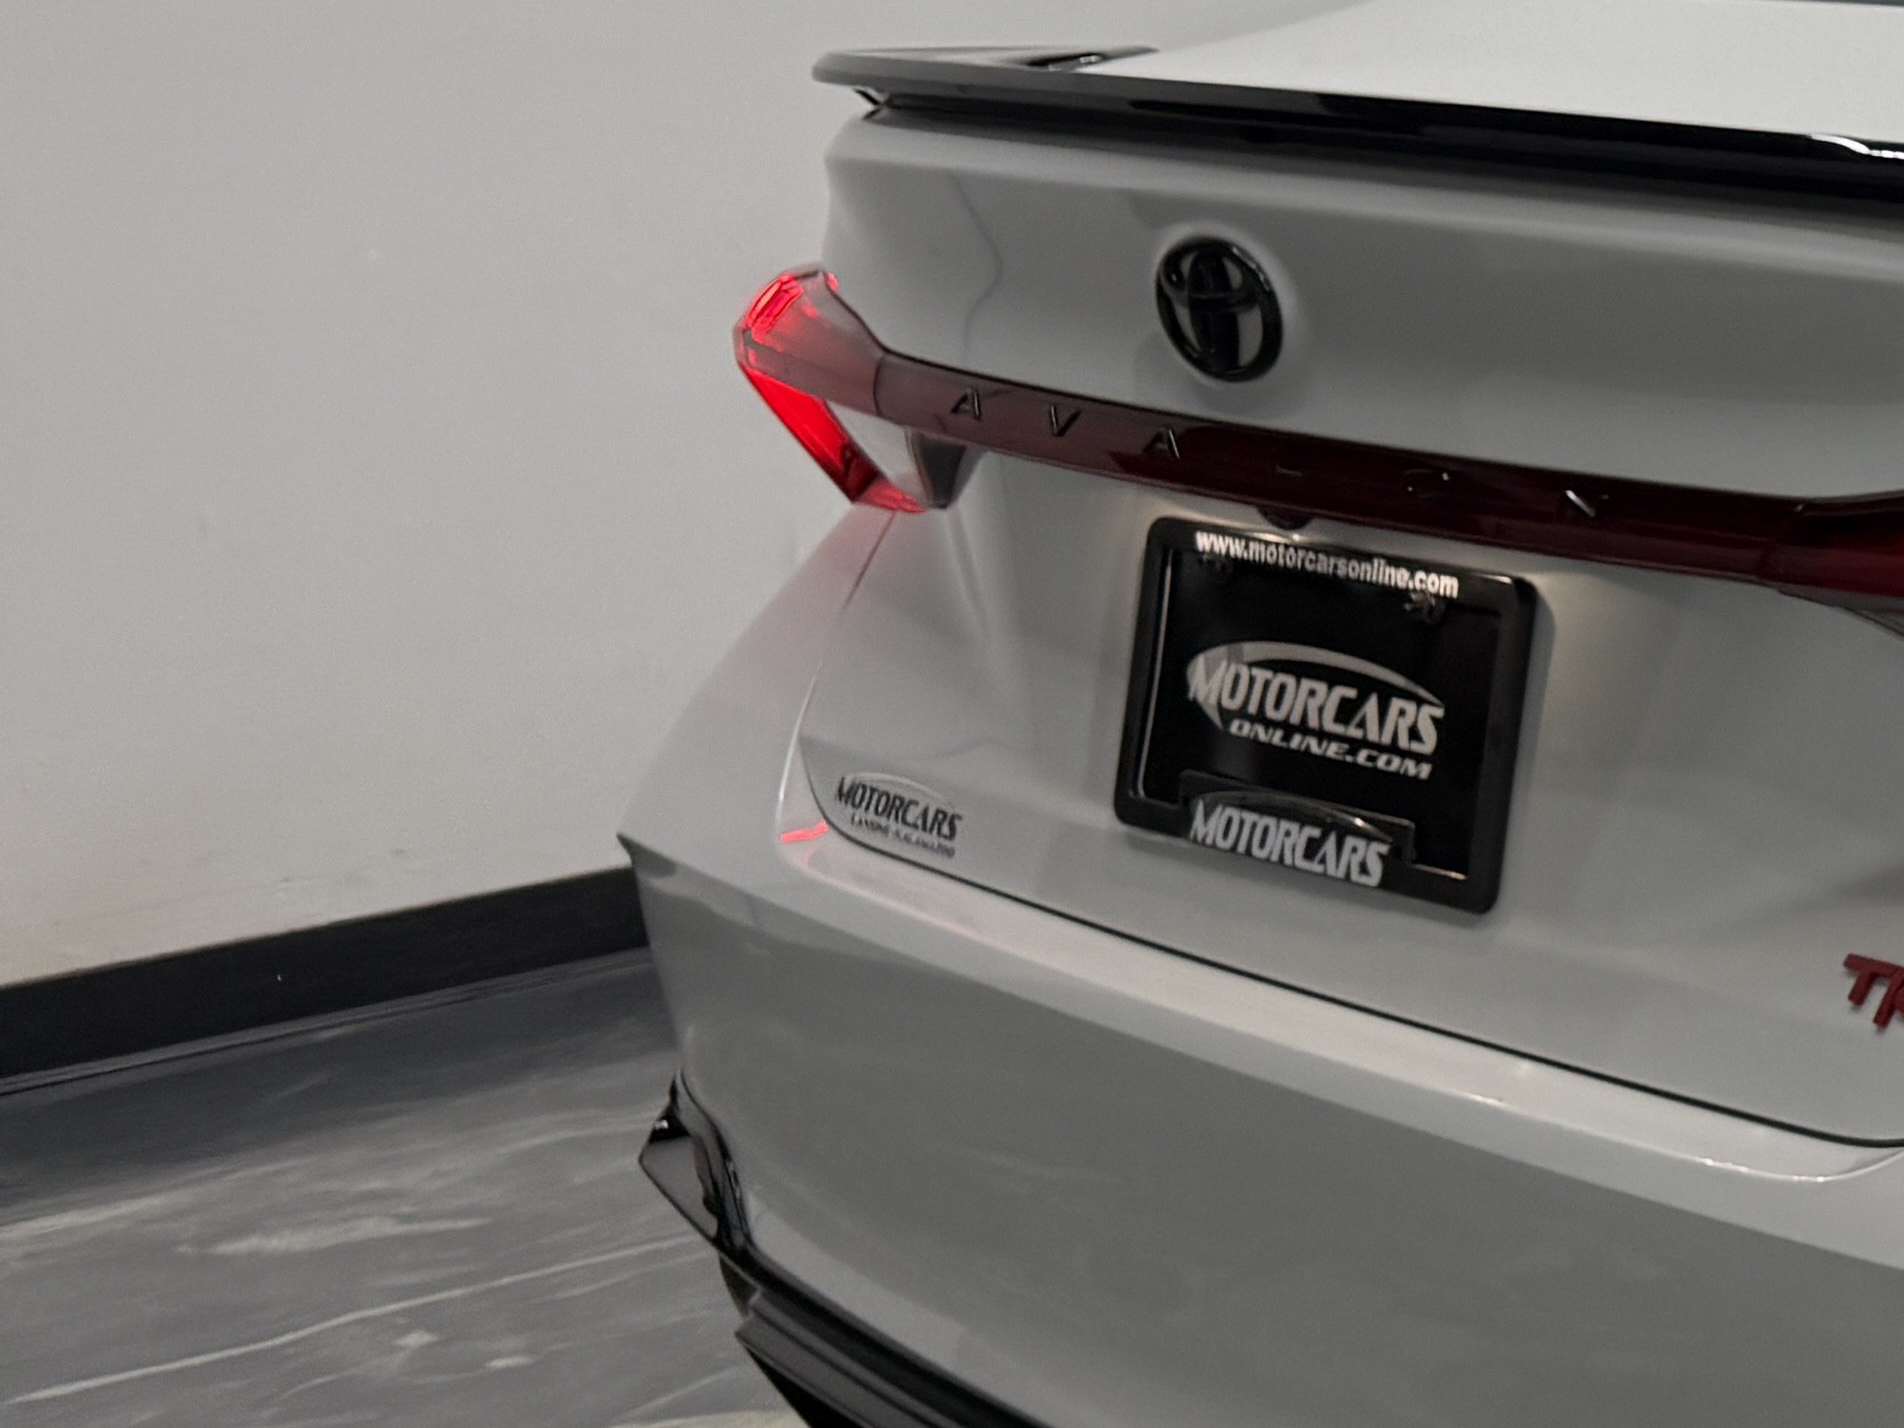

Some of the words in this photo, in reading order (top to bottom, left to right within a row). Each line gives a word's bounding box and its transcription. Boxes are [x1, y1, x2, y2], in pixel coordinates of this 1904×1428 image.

[951, 386, 1613, 520] AVAON
[1195, 531, 1459, 598] www.motorcarsonline.com
[1188, 652, 1445, 756] MOTORCARS
[1229, 720, 1433, 780] ONLINE.COM
[835, 776, 963, 841] MOTORCARS
[1189, 799, 1391, 888] MOTORCARS
